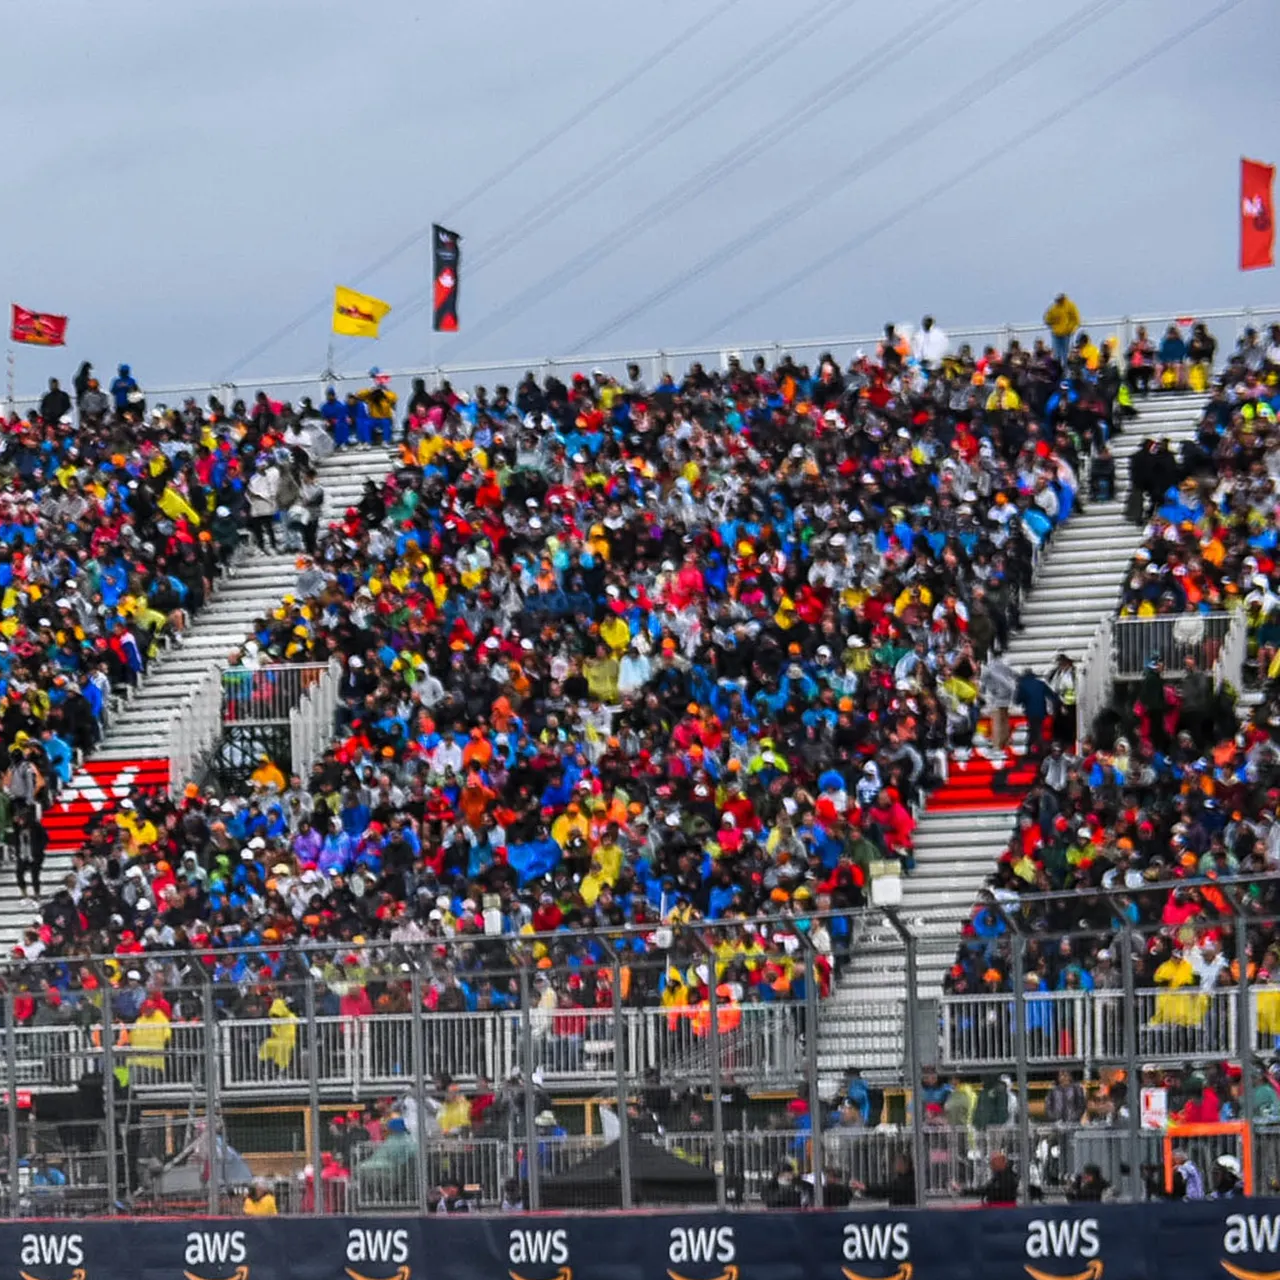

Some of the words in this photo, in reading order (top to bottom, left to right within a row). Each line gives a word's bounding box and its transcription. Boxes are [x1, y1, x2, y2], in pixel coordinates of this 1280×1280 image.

[22, 1235, 82, 1265] aws
[186, 1232, 245, 1264] aws
[347, 1230, 407, 1262] aws
[510, 1231, 567, 1263] aws
[670, 1228, 734, 1262] aws
[844, 1224, 908, 1260] aws
[1027, 1220, 1098, 1256] aws
[1225, 1215, 1280, 1252] aw
